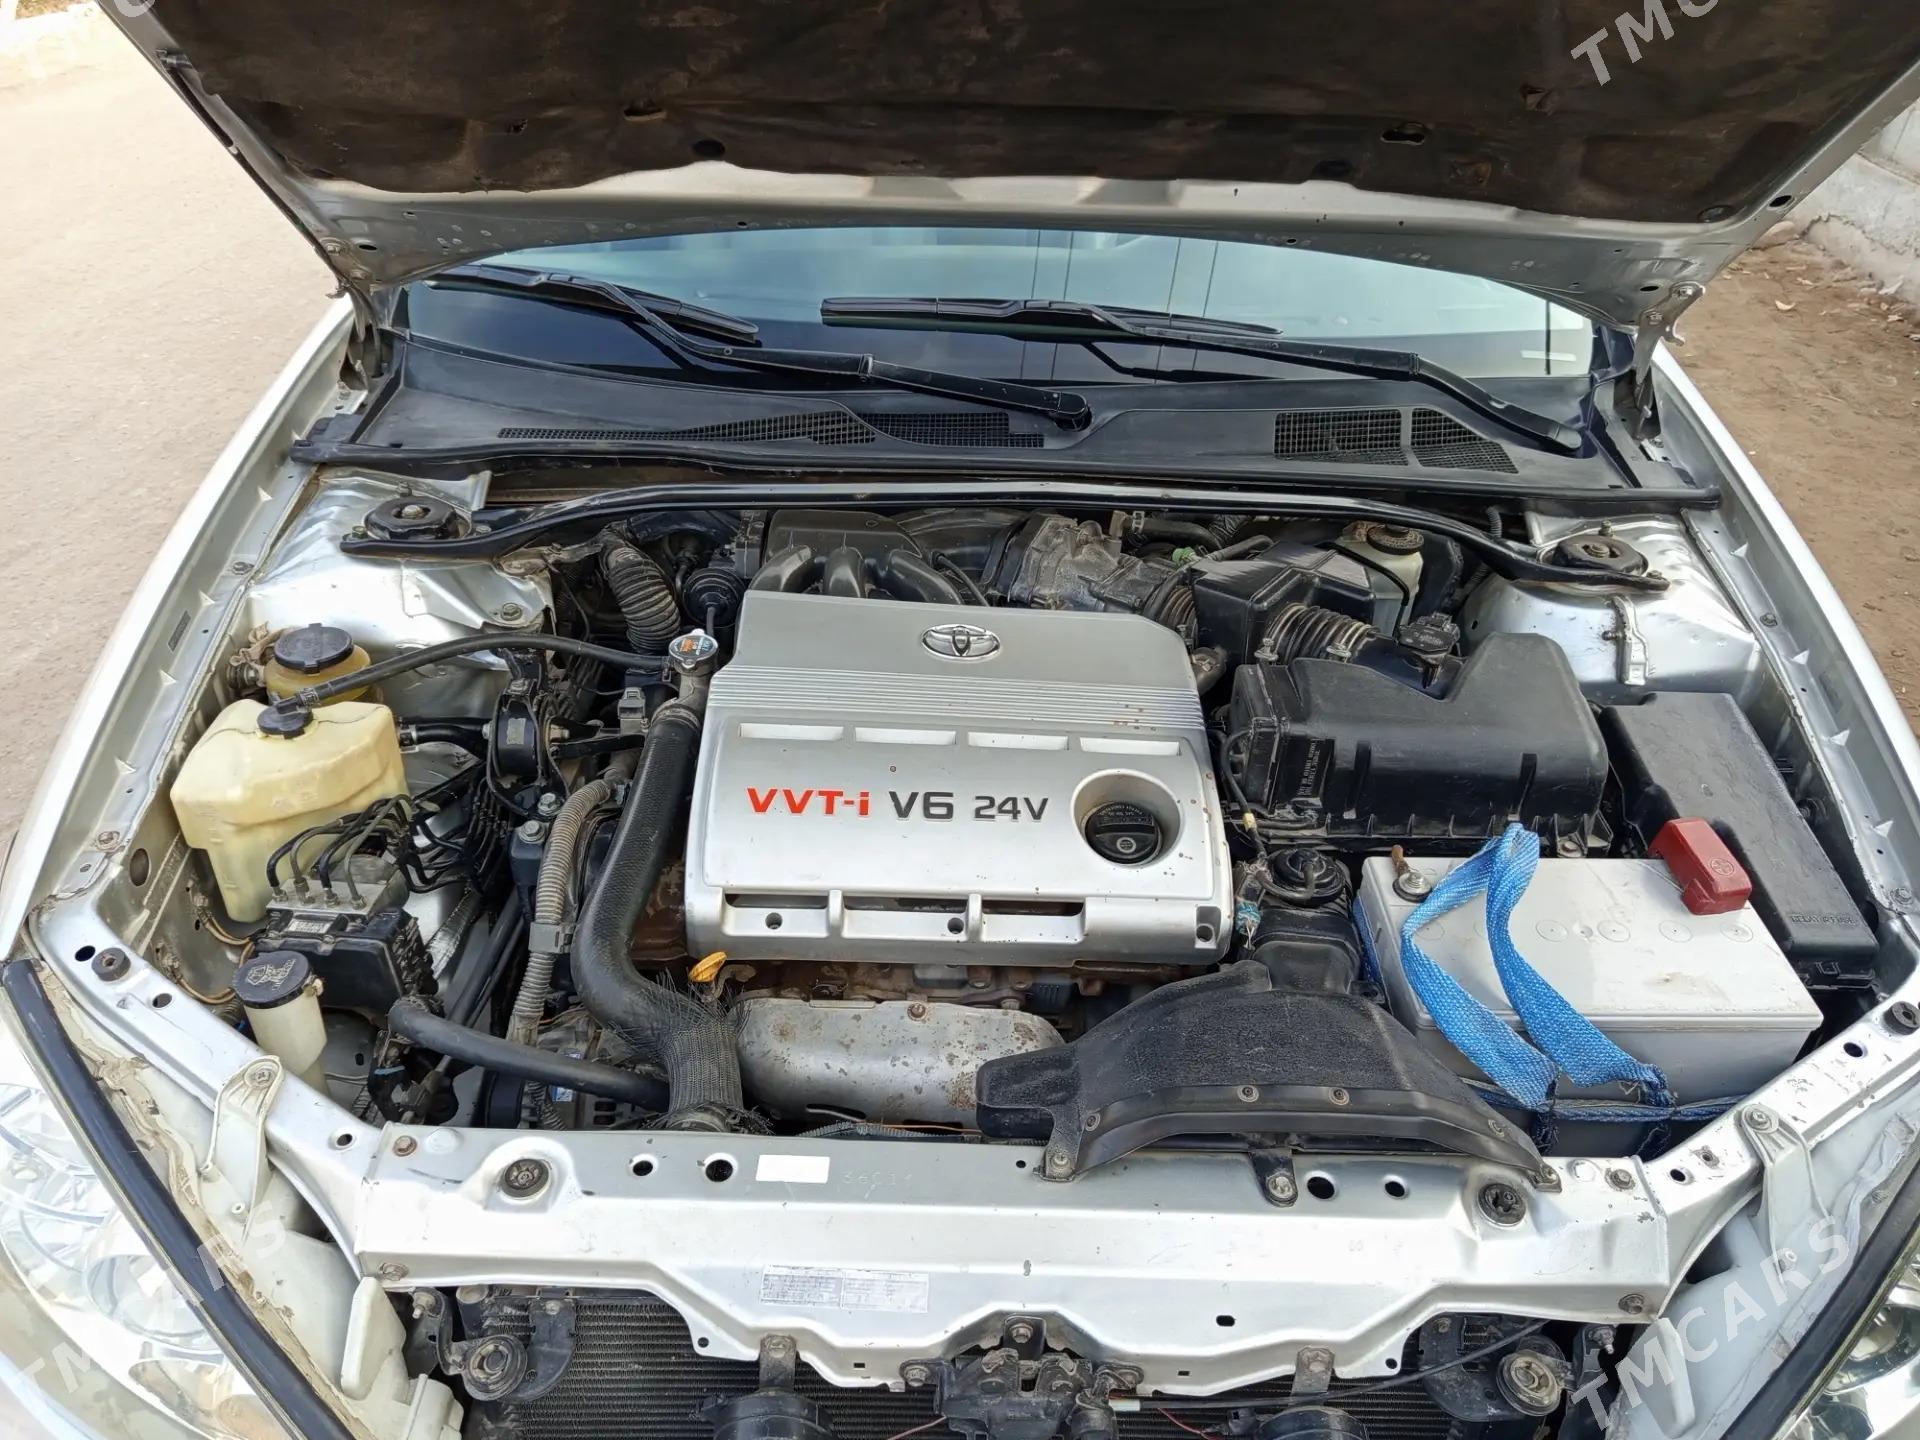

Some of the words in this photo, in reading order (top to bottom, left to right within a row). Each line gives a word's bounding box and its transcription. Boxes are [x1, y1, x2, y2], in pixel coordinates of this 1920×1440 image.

[746, 787, 870, 816] VVT-i
[888, 790, 955, 820] V6
[973, 795, 1050, 822] 24V
